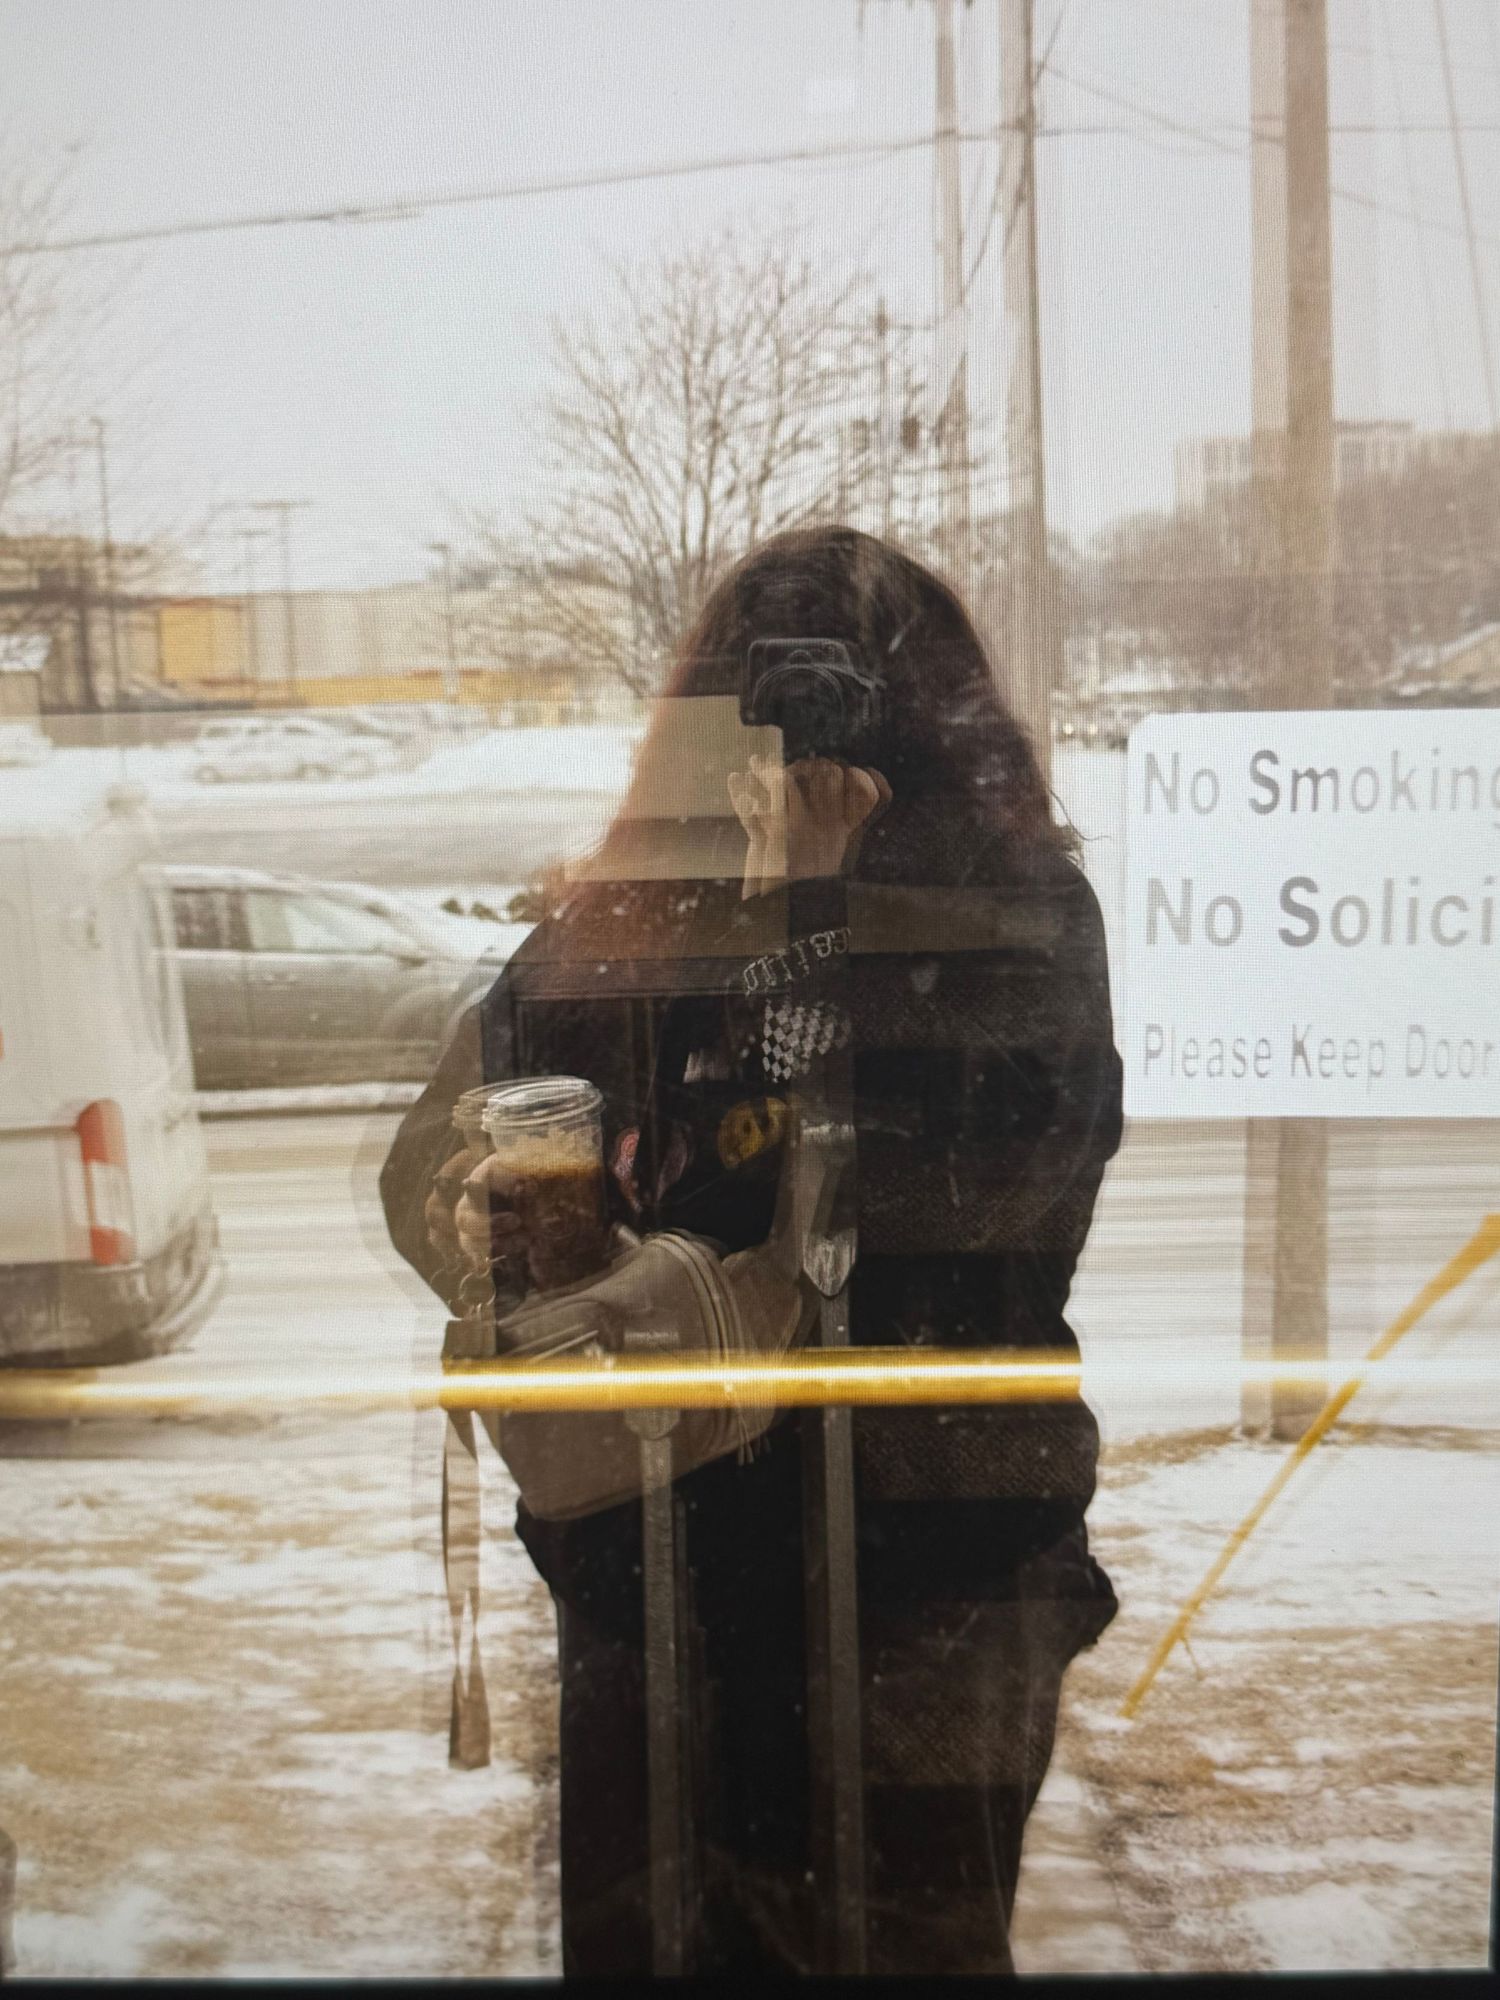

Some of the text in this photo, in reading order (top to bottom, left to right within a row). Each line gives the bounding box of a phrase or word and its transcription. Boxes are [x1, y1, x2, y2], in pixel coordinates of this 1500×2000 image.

[1144, 752, 1220, 815] No
[1146, 878, 1243, 947] No
[1143, 1024, 1272, 1078] Please
[1290, 1024, 1386, 1095] Keep
